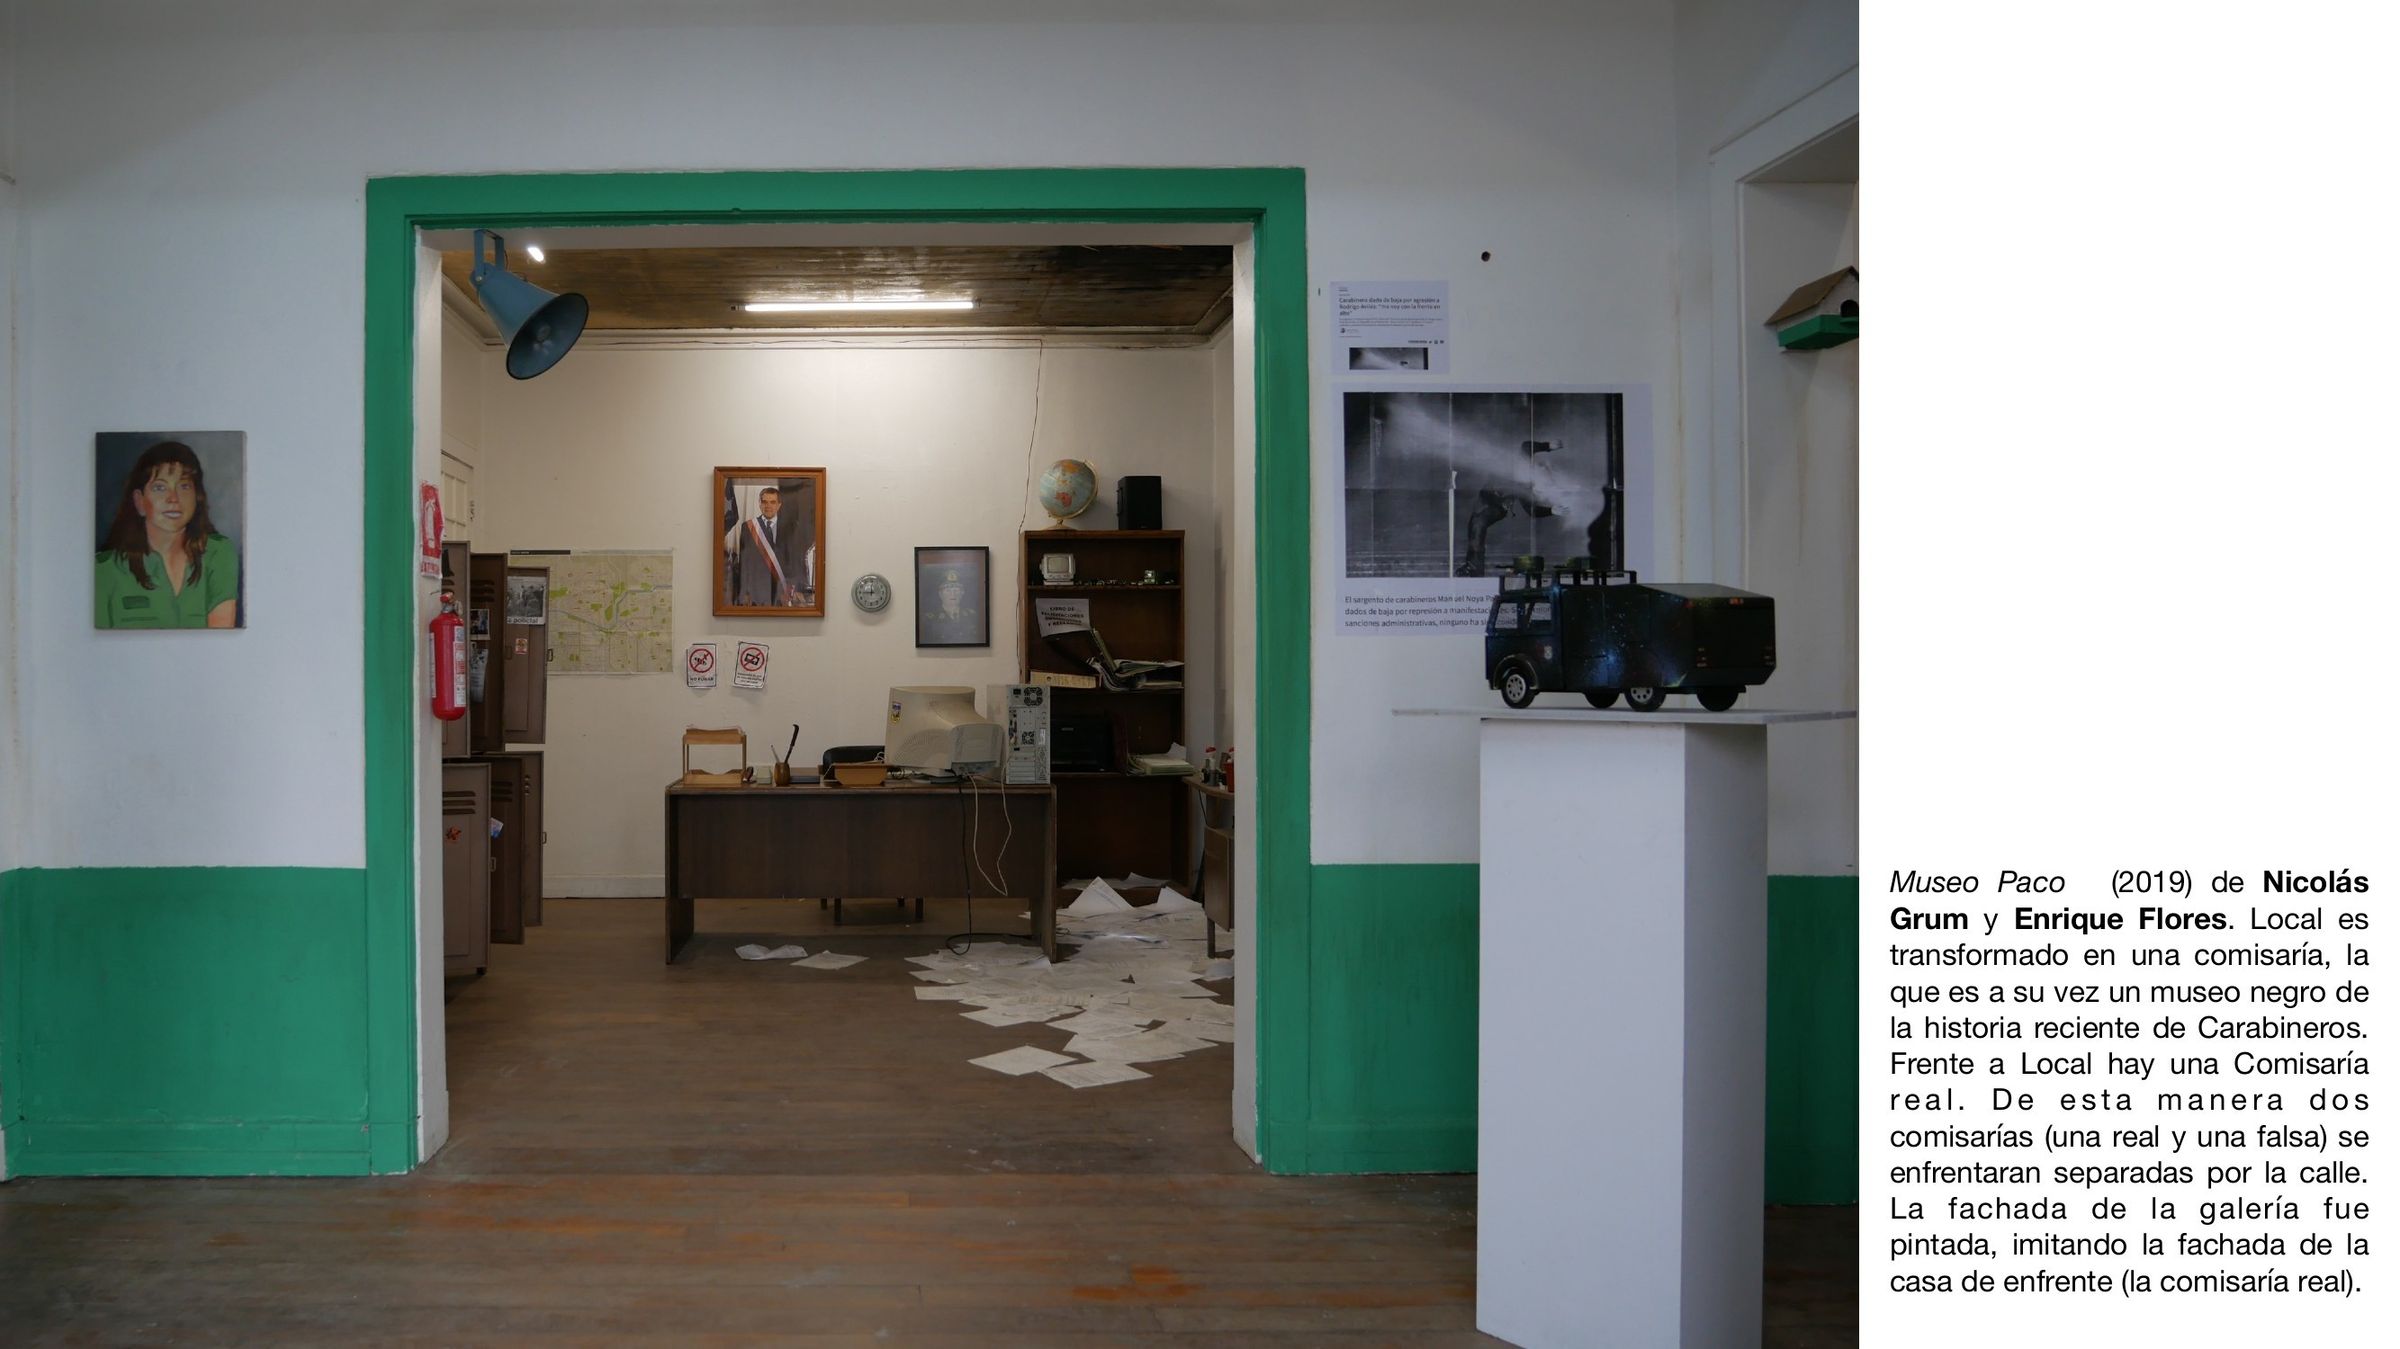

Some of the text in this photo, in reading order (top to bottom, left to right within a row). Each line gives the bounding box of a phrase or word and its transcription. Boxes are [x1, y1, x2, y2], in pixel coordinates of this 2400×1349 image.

[1345, 595, 1352, 603] El
[1353, 596, 1384, 605] sargento
[1466, 595, 1483, 604] Noya
[1378, 608, 1394, 616] baja
[1345, 619, 1380, 627] sanciones
[1381, 619, 1438, 627] administrativas,
[1440, 619, 1468, 627] ninguno
[1469, 618, 1480, 626] ha
